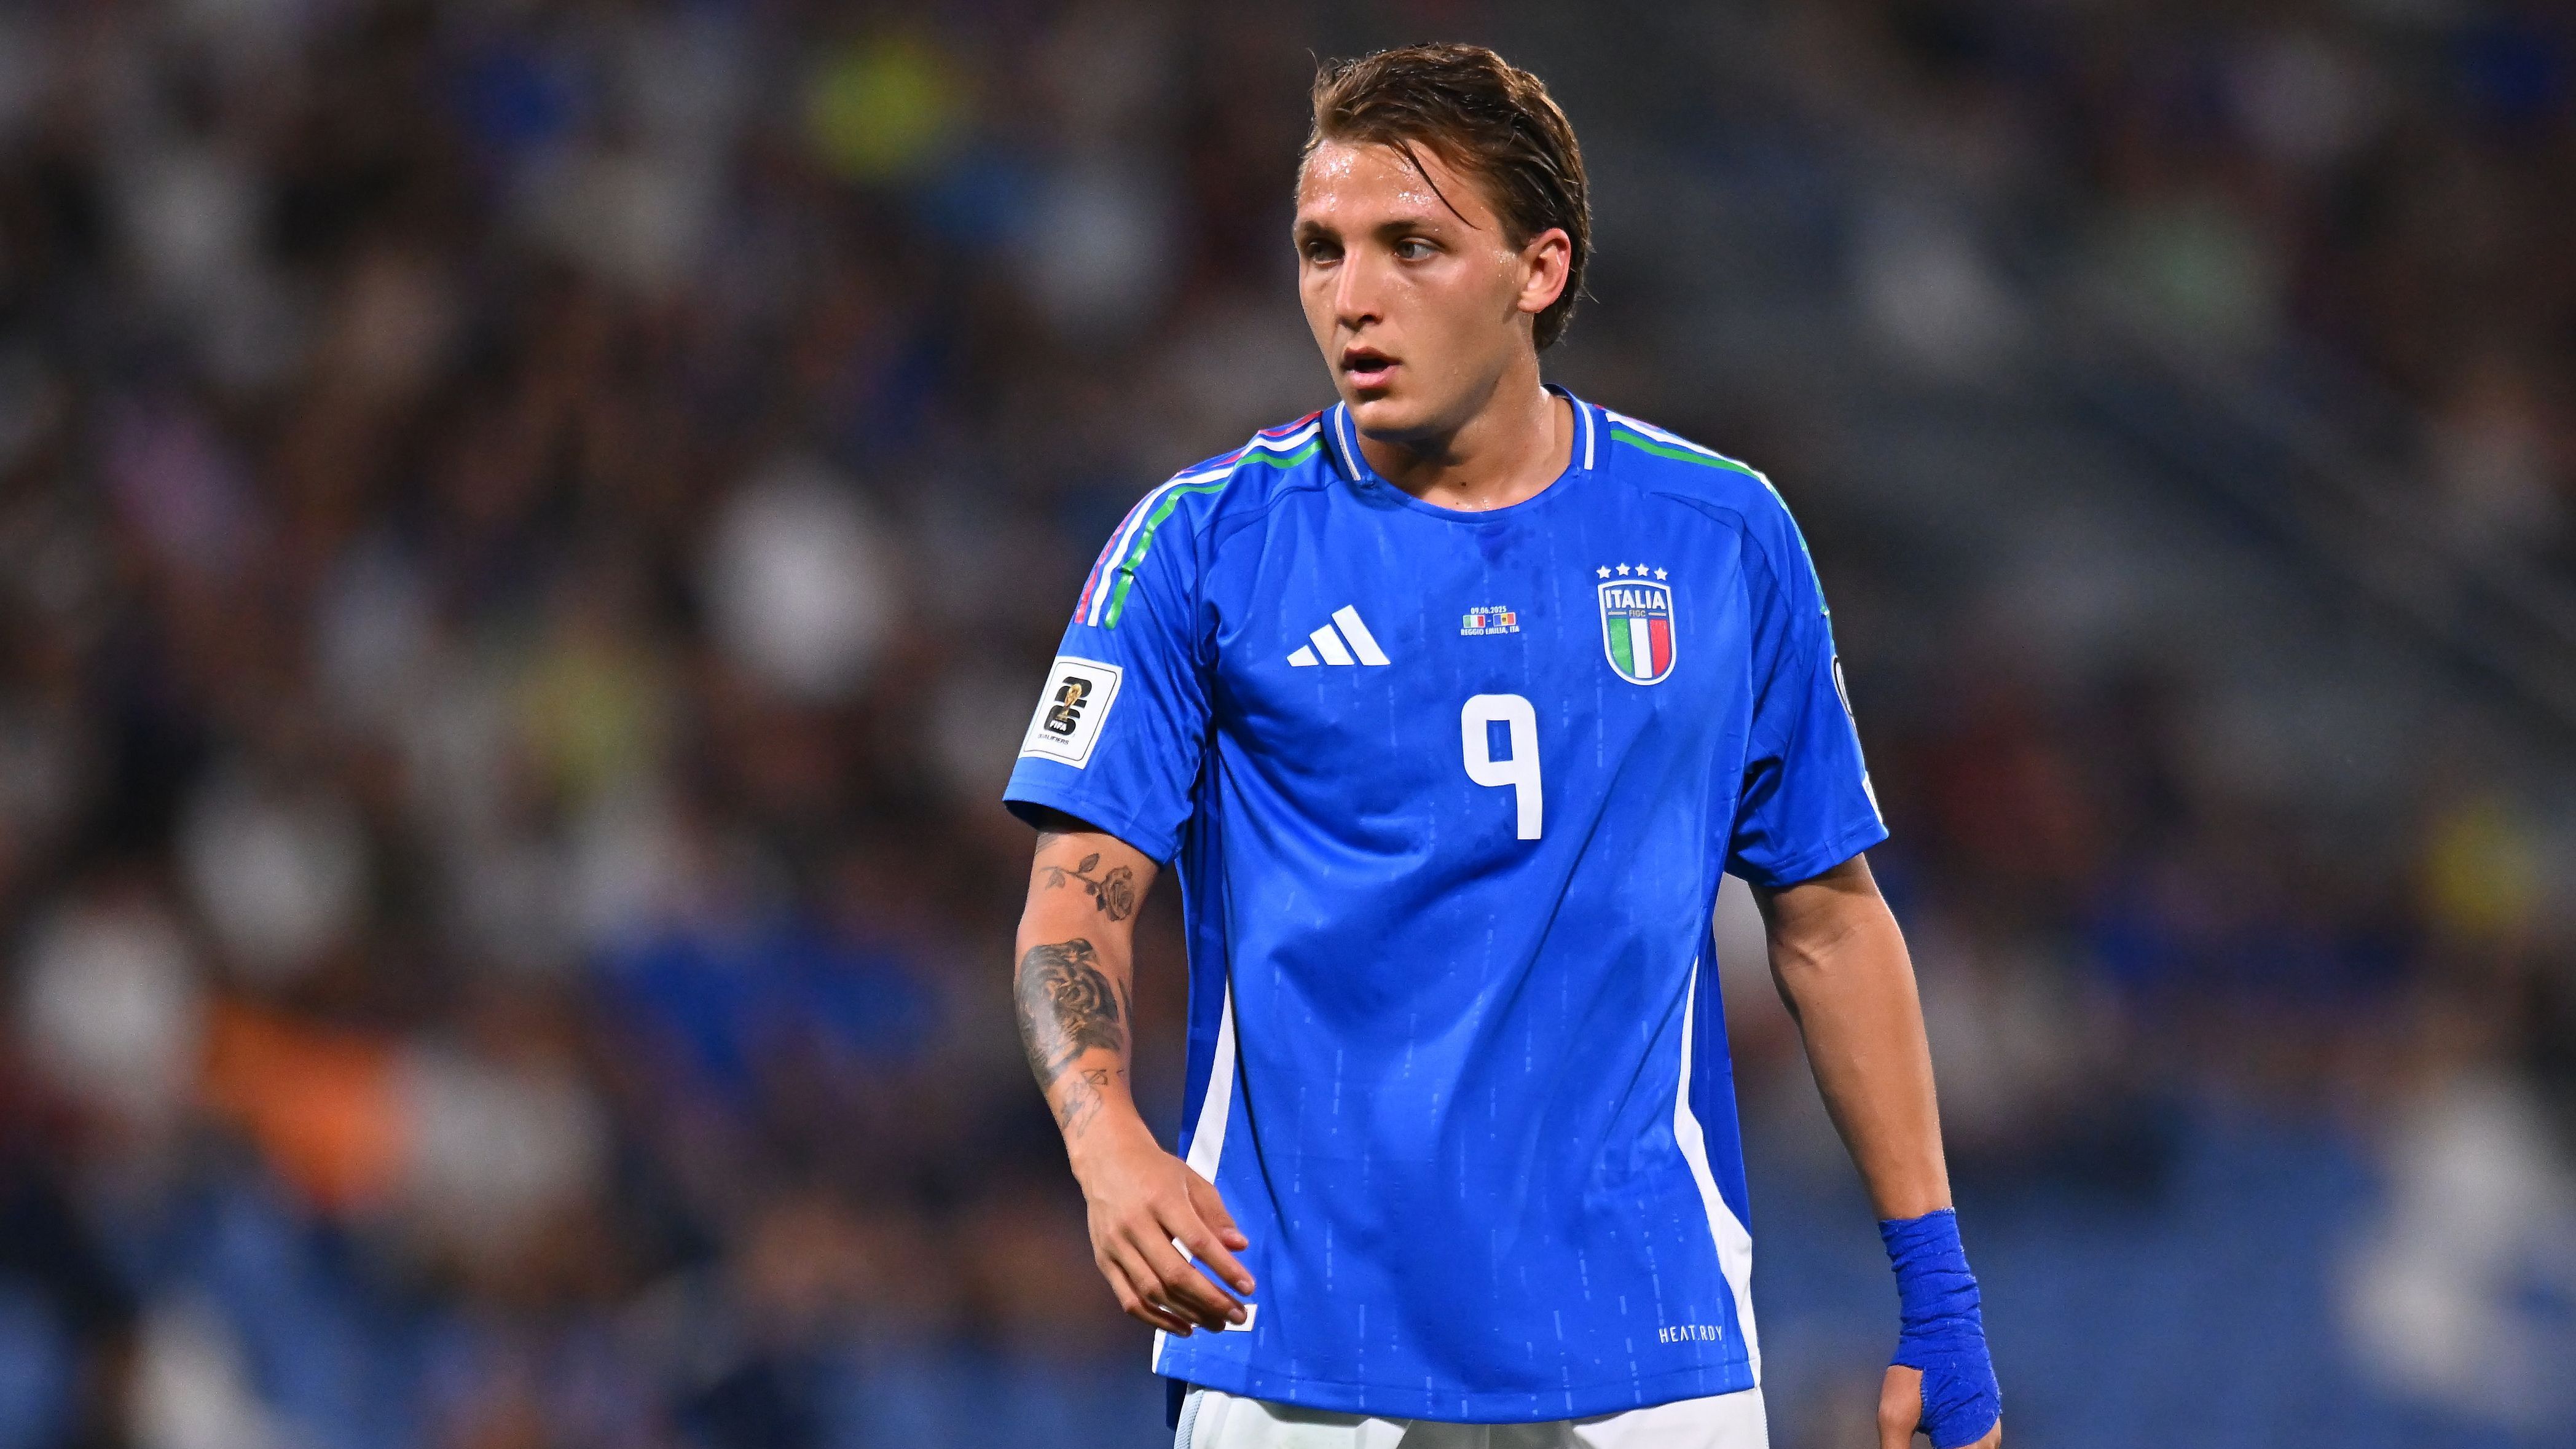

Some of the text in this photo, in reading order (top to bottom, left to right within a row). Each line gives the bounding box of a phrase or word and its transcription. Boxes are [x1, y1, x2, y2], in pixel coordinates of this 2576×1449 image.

[1604, 589, 1666, 610] ITALIA
[1470, 605, 1507, 615] 09.06.2025
[1485, 626, 1508, 635] EMILIA,
[1049, 720, 1067, 731] FIFA
[1461, 694, 1542, 840] 9
[1659, 1324, 1722, 1344] HEAT.RDY
